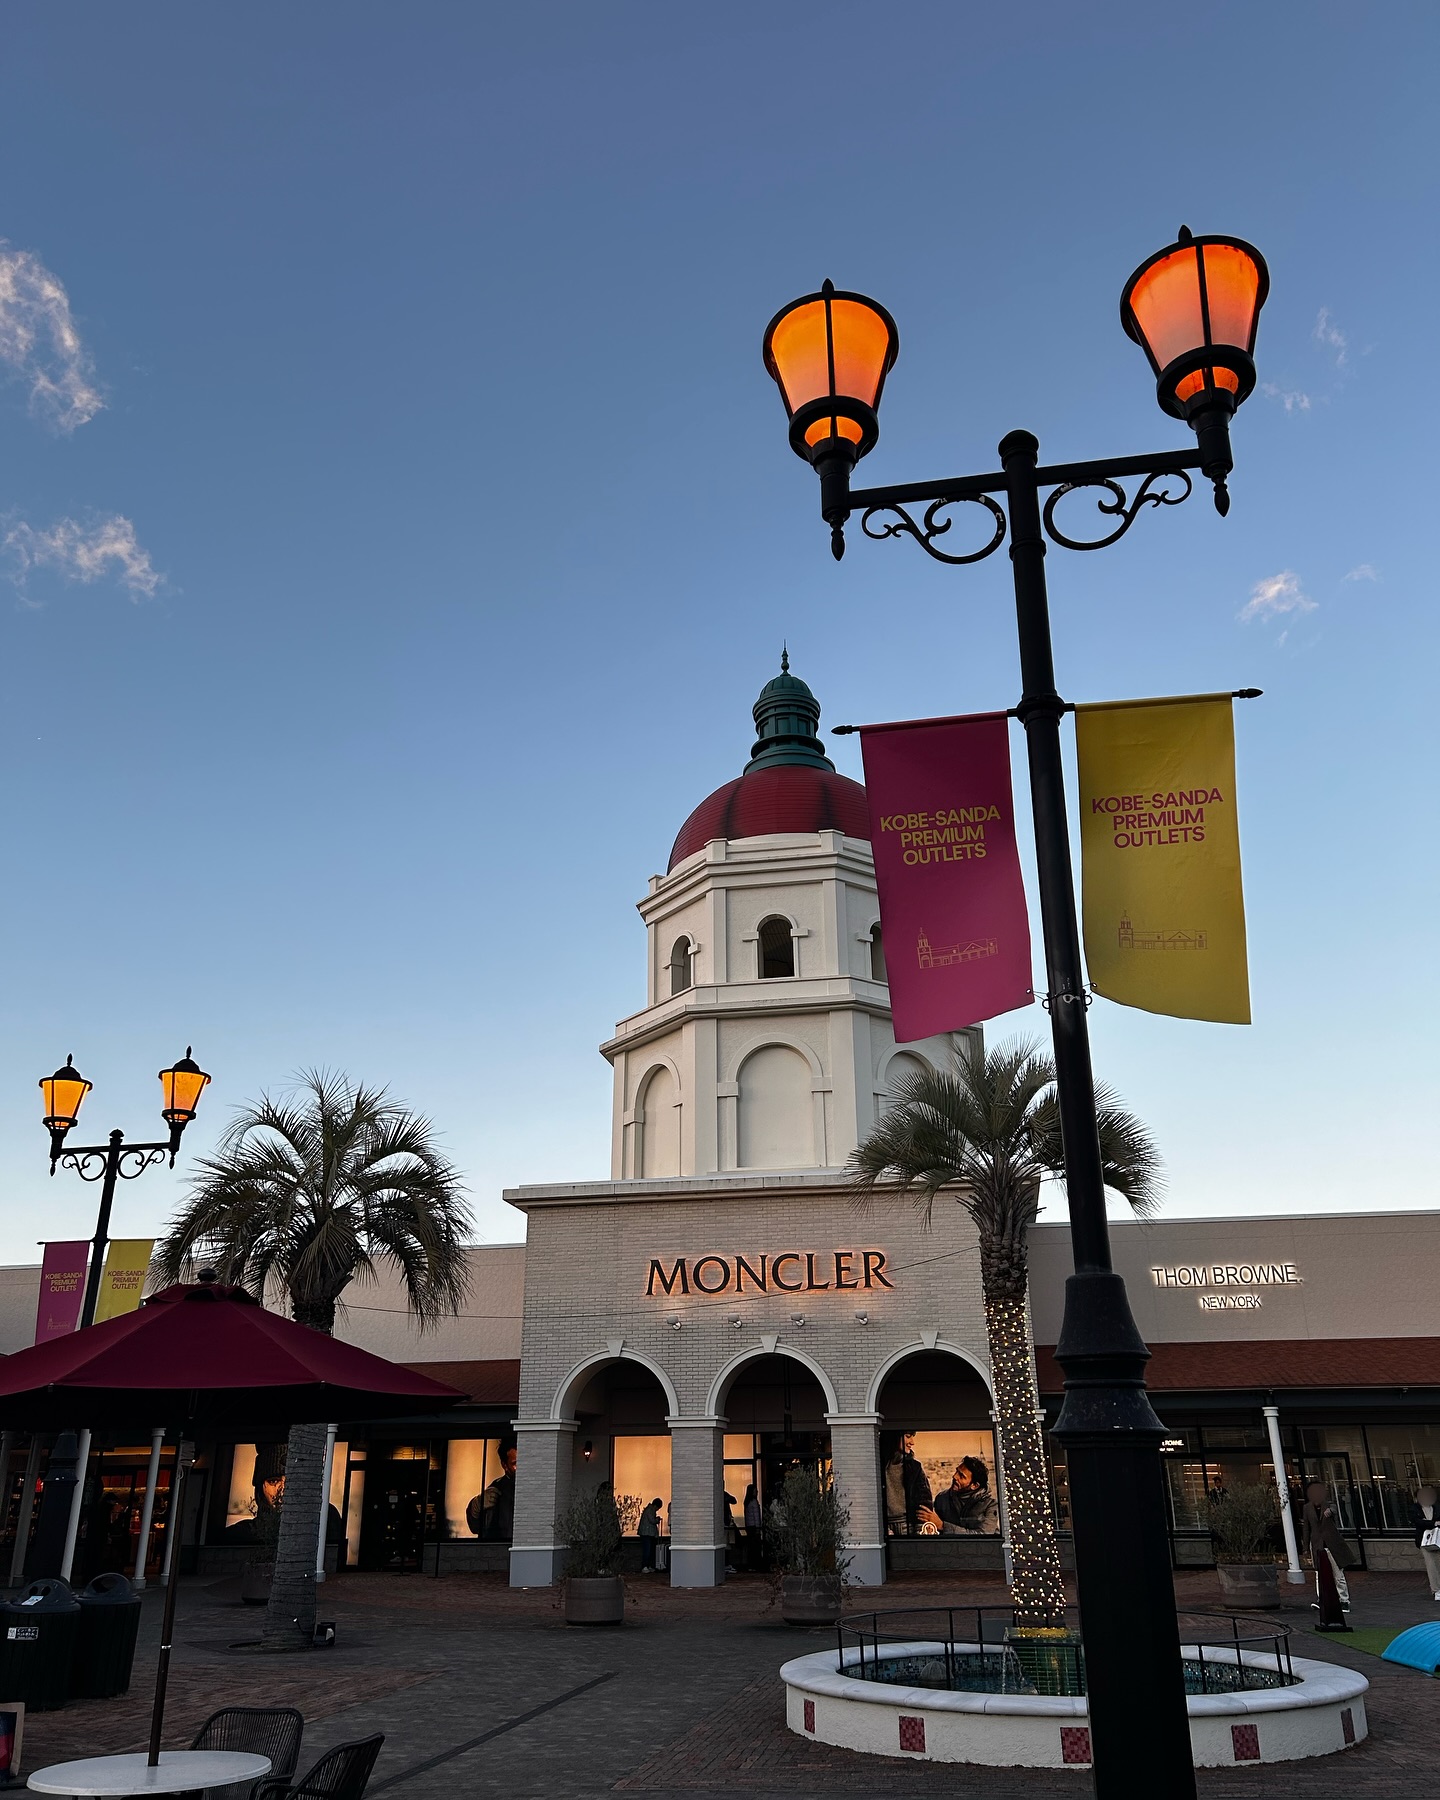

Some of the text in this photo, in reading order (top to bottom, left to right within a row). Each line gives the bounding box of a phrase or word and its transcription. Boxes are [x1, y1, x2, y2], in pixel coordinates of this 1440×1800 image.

[1091, 787, 1224, 814] KOBE-SANDA
[879, 804, 1002, 832] KOBE-SANDA
[1112, 807, 1205, 831] PREMIUM
[900, 824, 985, 848] PREMIUM
[1113, 825, 1206, 849] OUTLETS
[902, 841, 988, 866] OUTLETS
[645, 1250, 895, 1296] MONCLER
[1151, 1266, 1208, 1287] THOM
[1202, 1295, 1263, 1309] NEW YORK
